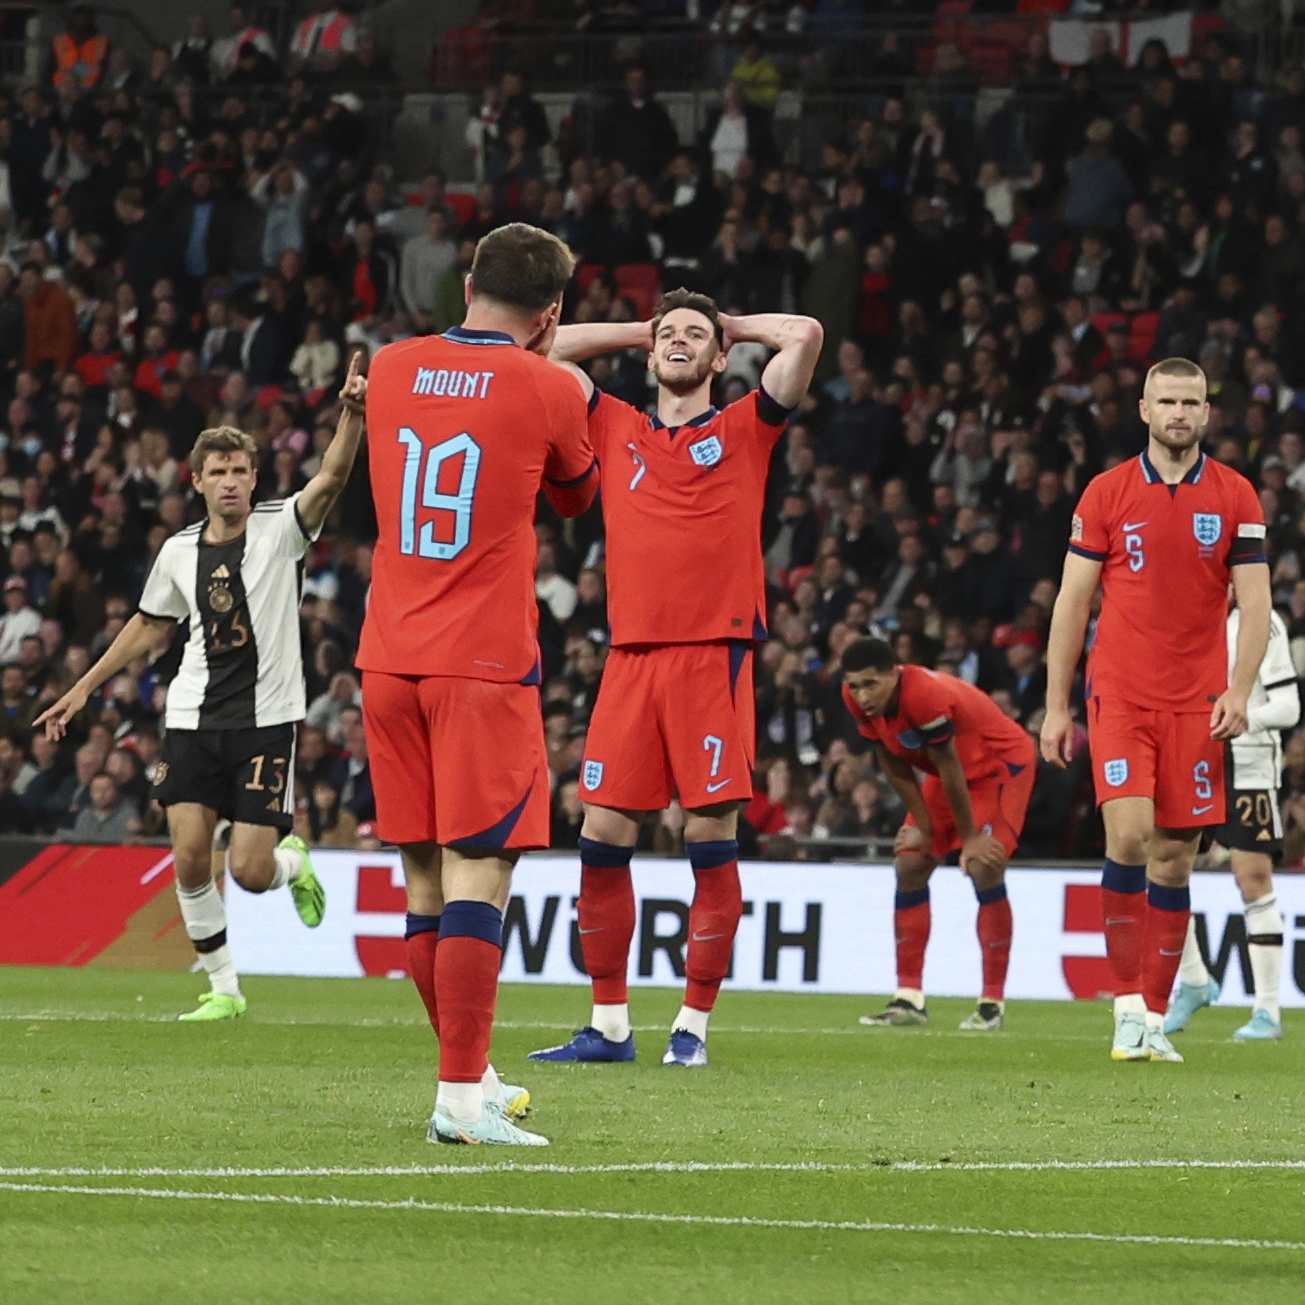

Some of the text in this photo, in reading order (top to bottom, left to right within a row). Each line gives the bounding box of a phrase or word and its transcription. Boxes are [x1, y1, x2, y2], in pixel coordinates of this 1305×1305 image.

[411, 366, 495, 399] MOUNT
[397, 426, 482, 561] 19
[1125, 533, 1145, 573] 5
[244, 754, 287, 794] 13
[703, 734, 723, 777] 7
[1193, 759, 1212, 800] 5
[1235, 793, 1271, 827] 20
[501, 894, 823, 983] WRH
